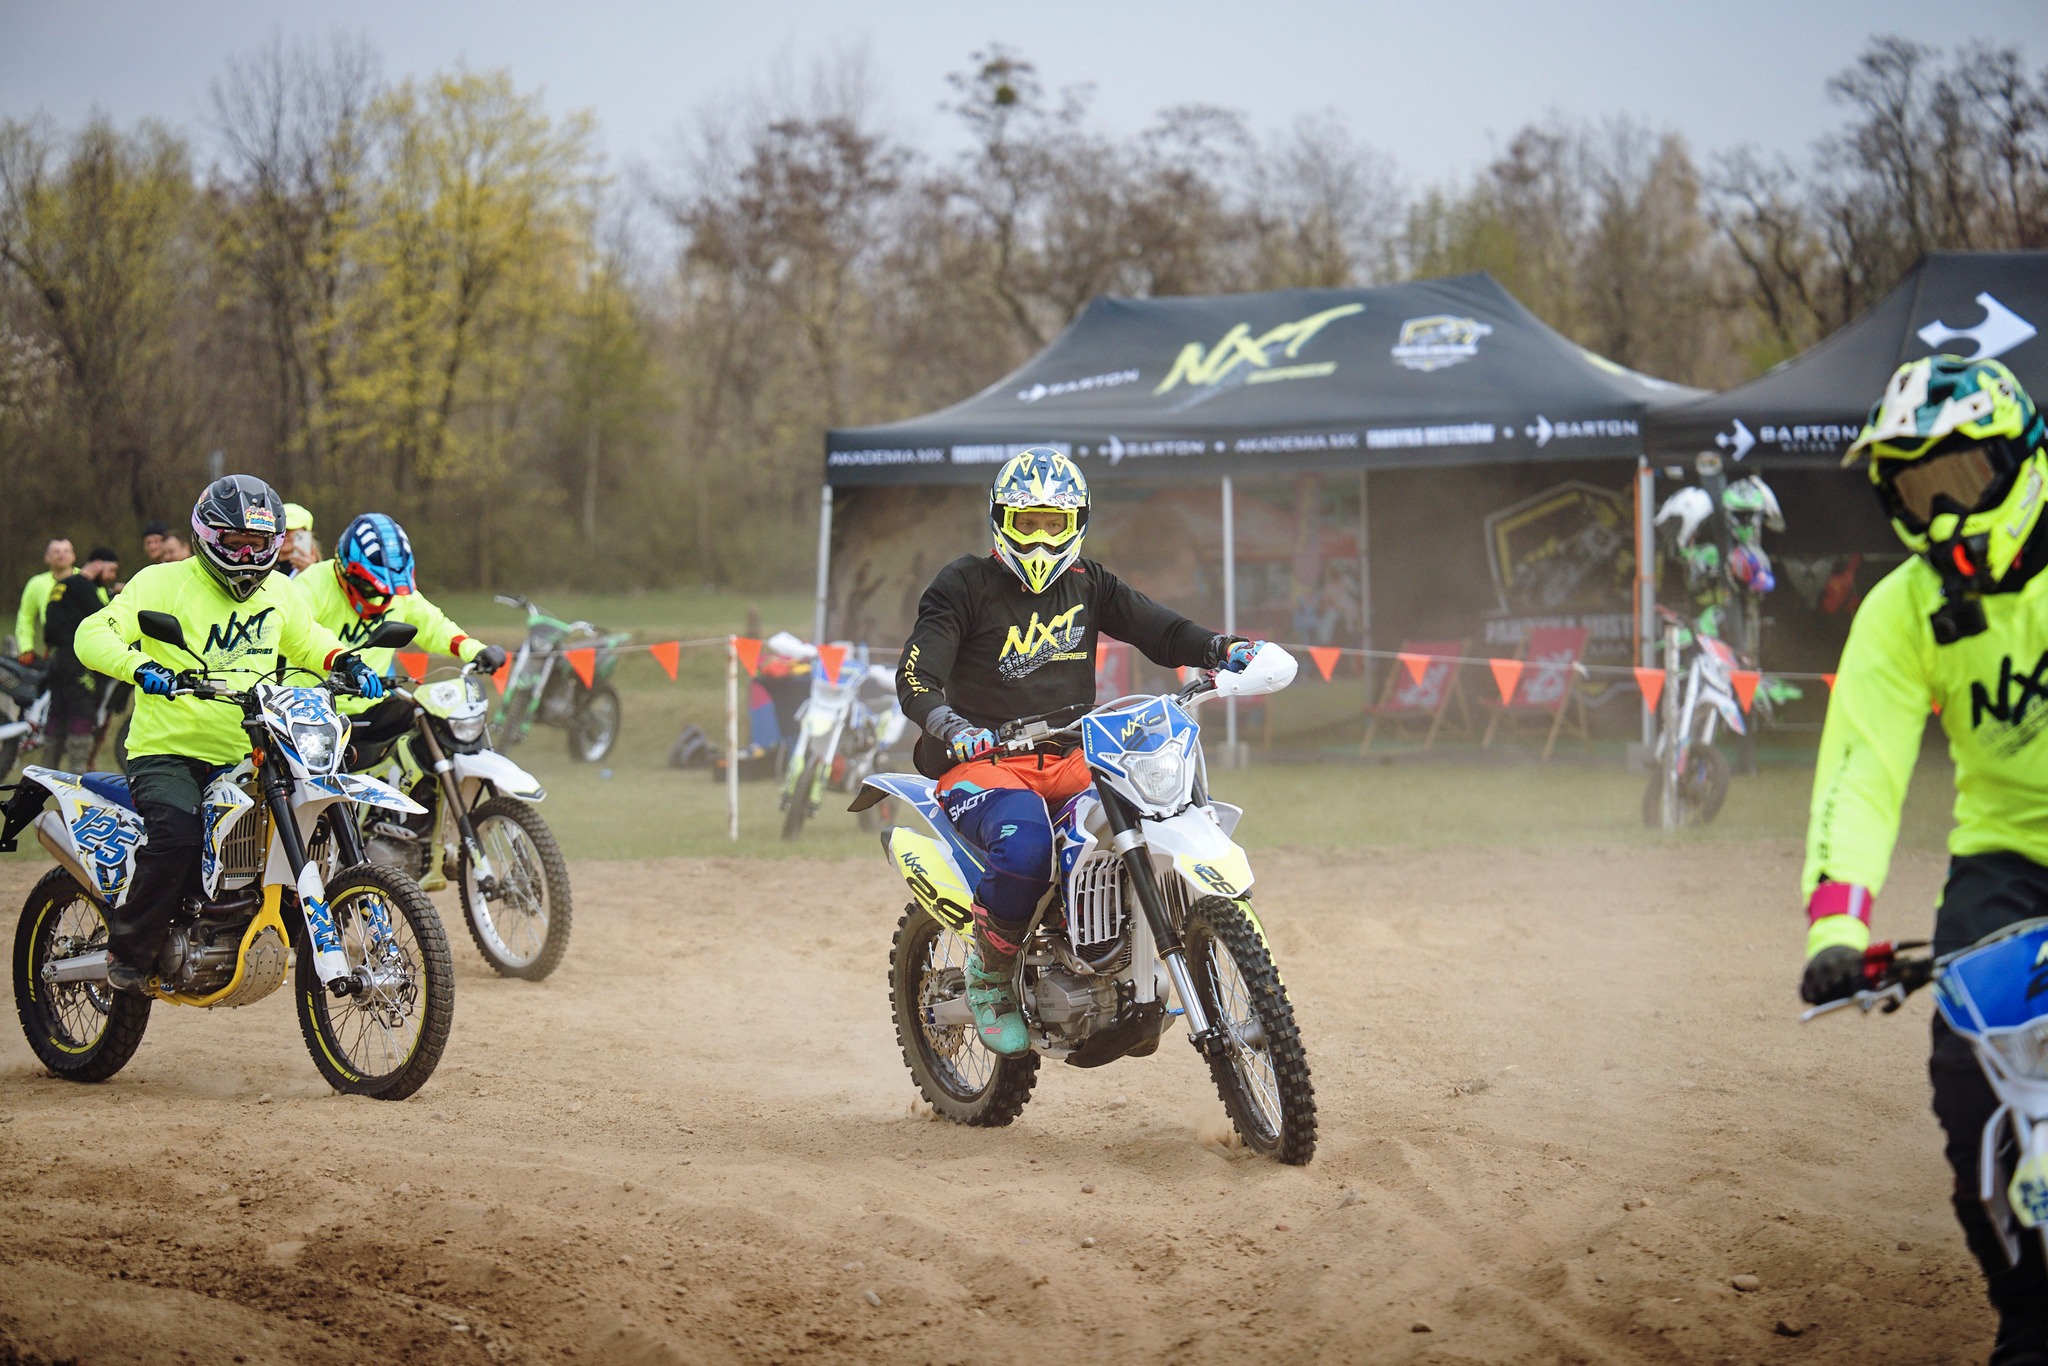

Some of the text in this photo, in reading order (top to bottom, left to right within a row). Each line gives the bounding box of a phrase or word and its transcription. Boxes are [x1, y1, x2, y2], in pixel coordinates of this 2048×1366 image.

[1152, 302, 1366, 396] NXT
[1049, 369, 1140, 396] BARTON
[1234, 435, 1328, 453] AKADEMIA
[1329, 432, 1360, 450] MX
[1554, 419, 1639, 439] BARTON
[1760, 425, 1859, 443] BARTON
[828, 449, 916, 465] AKADEMIA
[917, 448, 946, 464] MX
[1126, 440, 1206, 458] BARTON
[202, 607, 275, 655] NXT
[998, 603, 1084, 661] NXT
[1051, 651, 1088, 661] SERIES
[1086, 723, 1094, 755] BARTON
[1121, 710, 1150, 743] NXT
[949, 789, 995, 822] SHOT
[72, 807, 140, 868] 125
[901, 852, 928, 876] NXT
[906, 869, 974, 931] 28
